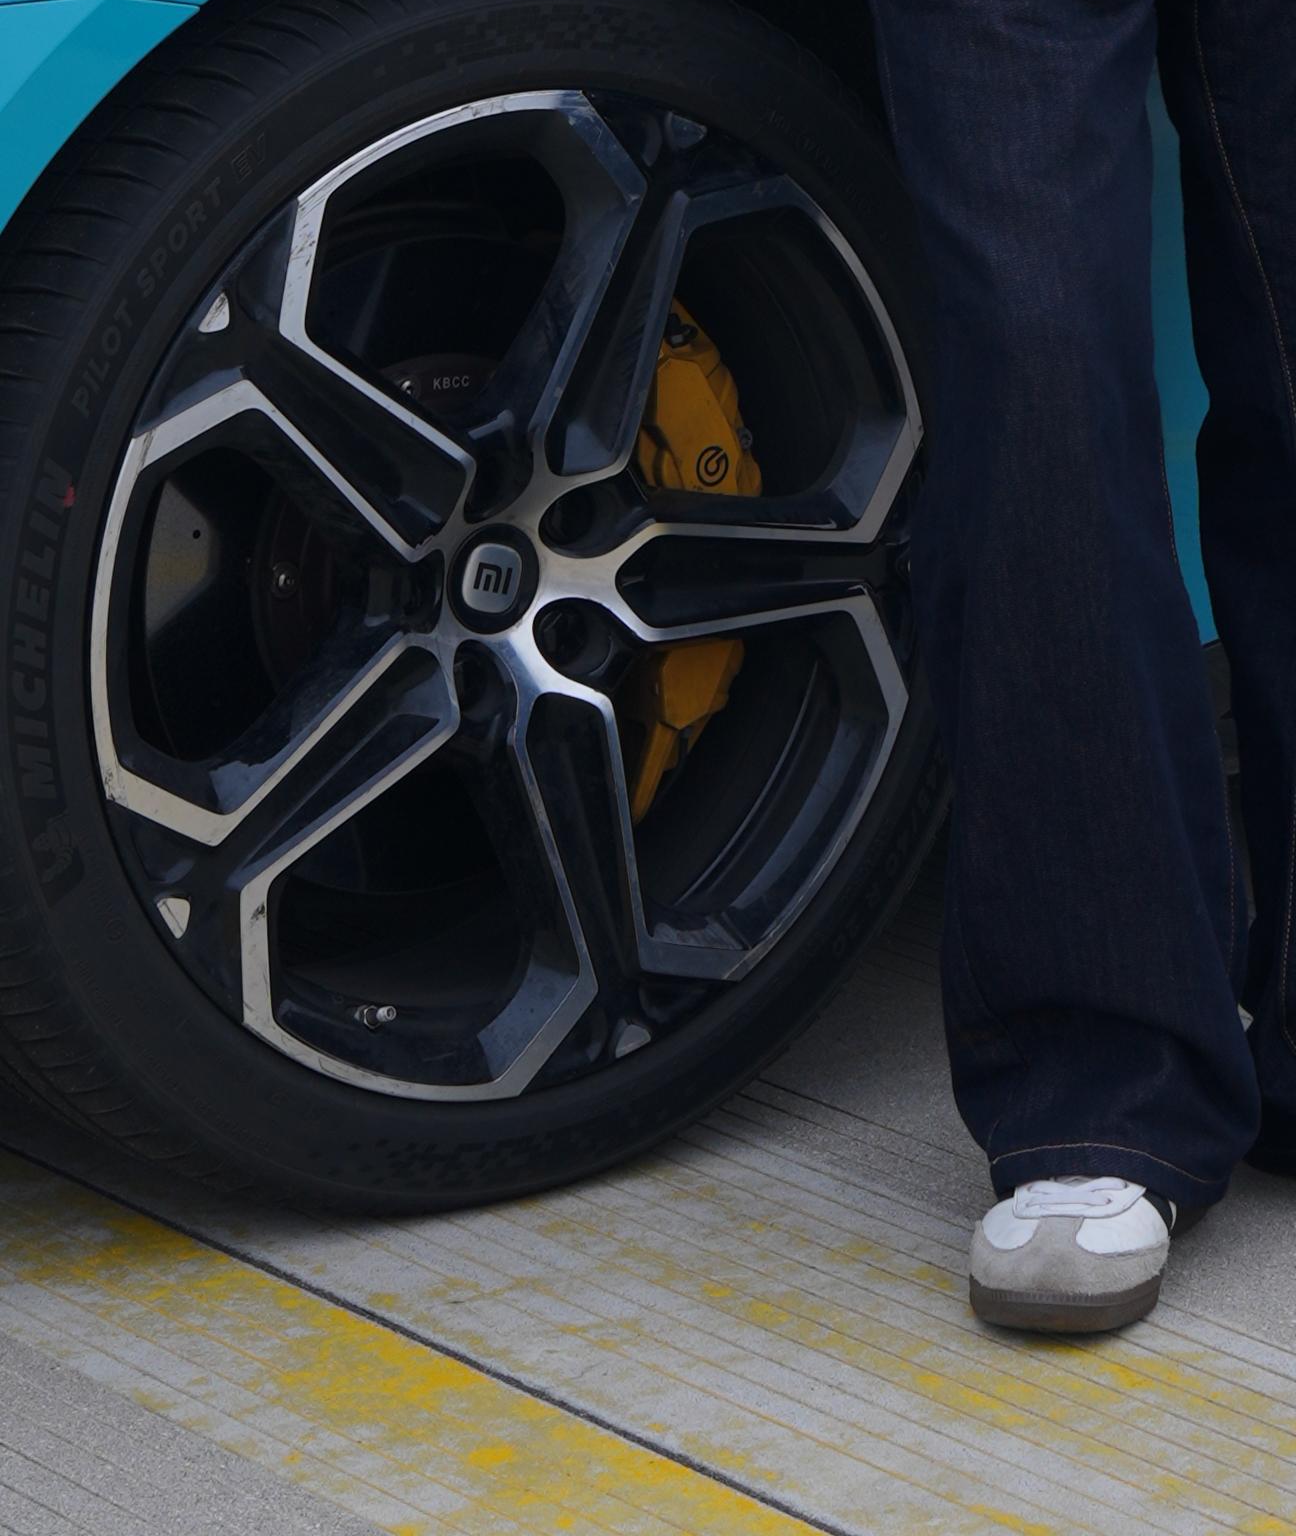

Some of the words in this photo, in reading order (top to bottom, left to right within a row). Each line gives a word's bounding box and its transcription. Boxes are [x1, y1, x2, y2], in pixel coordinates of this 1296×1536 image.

[71, 299, 132, 416] PILOT
[137, 176, 222, 298] SPORT
[10, 457, 75, 802] MICHELIN
